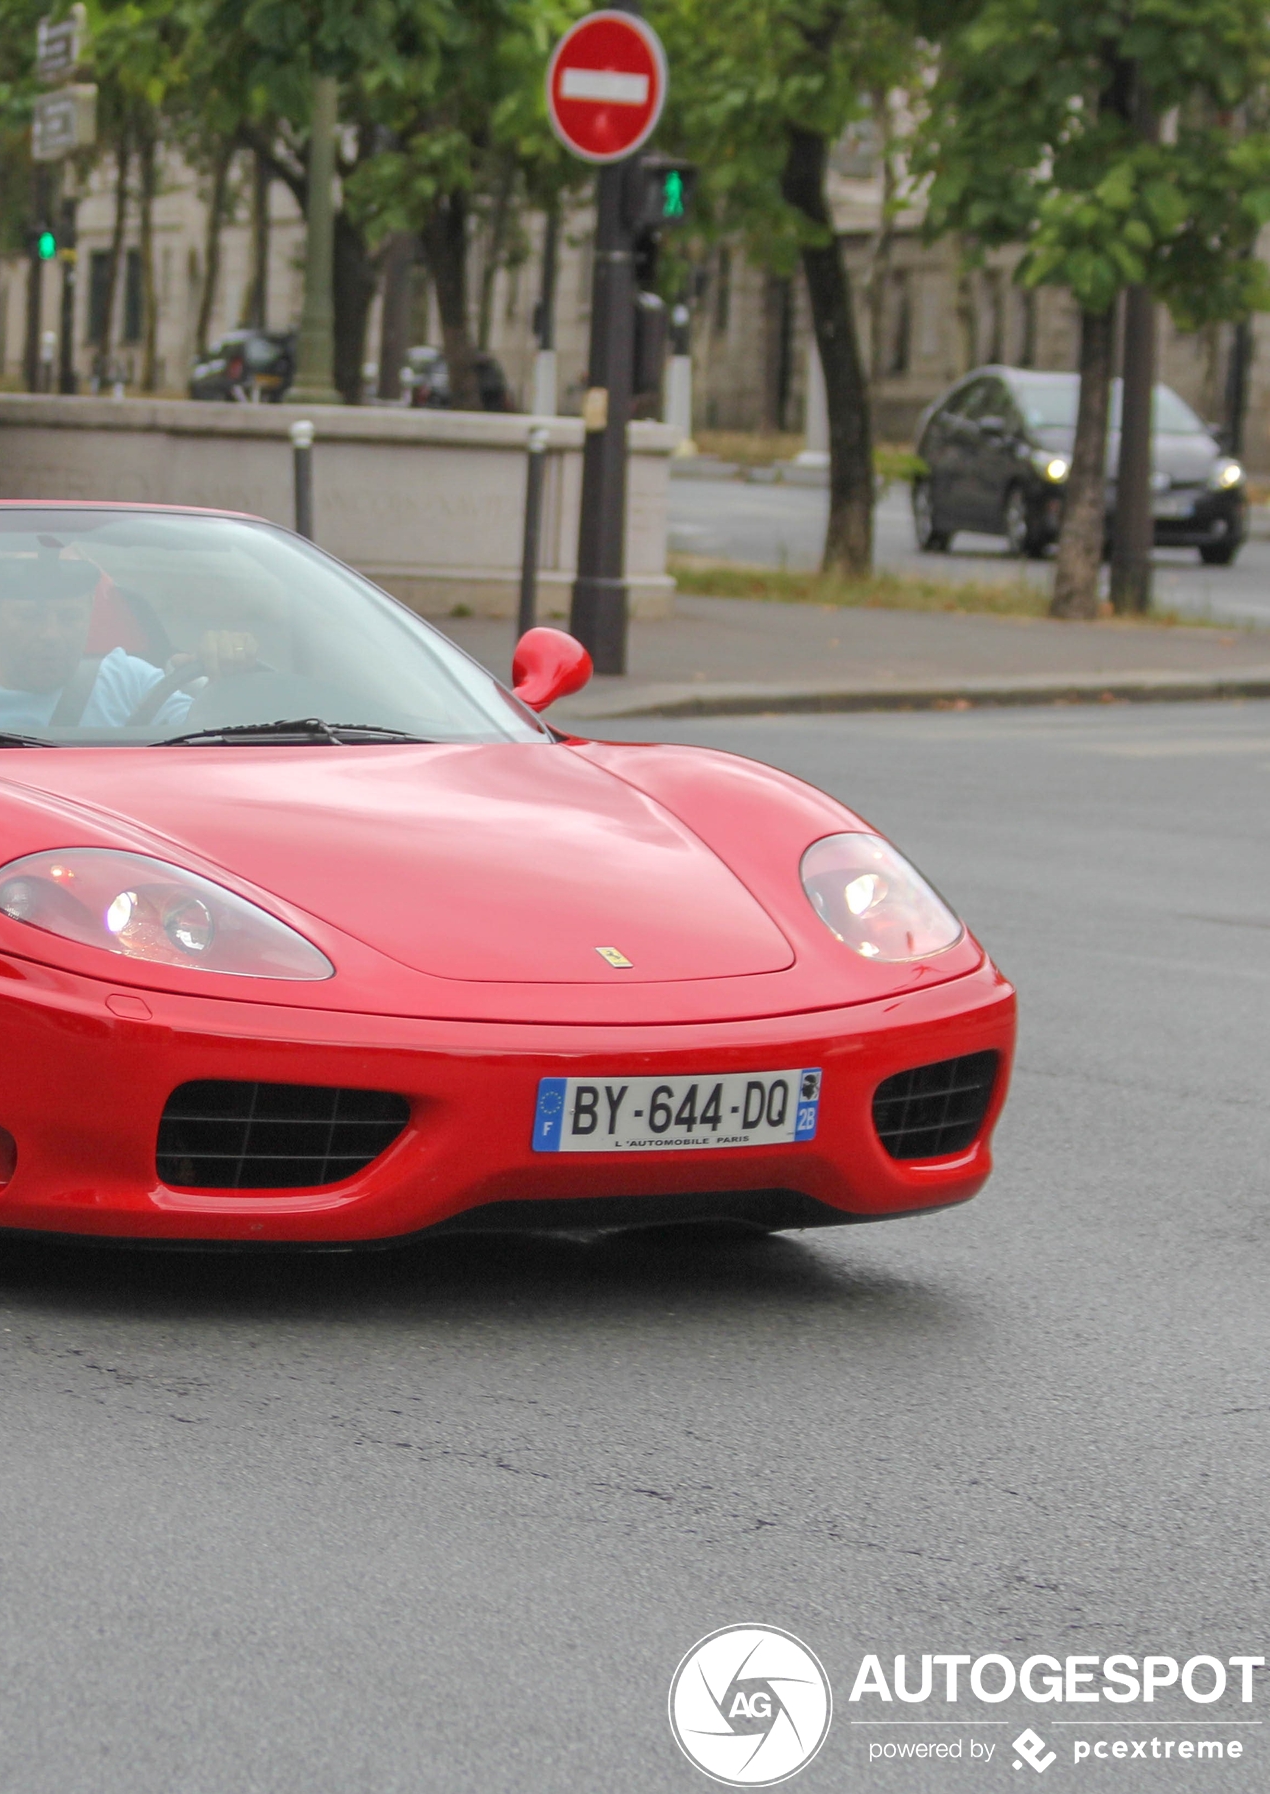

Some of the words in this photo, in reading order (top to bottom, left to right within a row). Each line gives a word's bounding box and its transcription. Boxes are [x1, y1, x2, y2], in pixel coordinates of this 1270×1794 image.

[797, 1107, 816, 1131] 2B
[543, 1121, 554, 1136] F
[717, 1135, 750, 1143] PARIS
